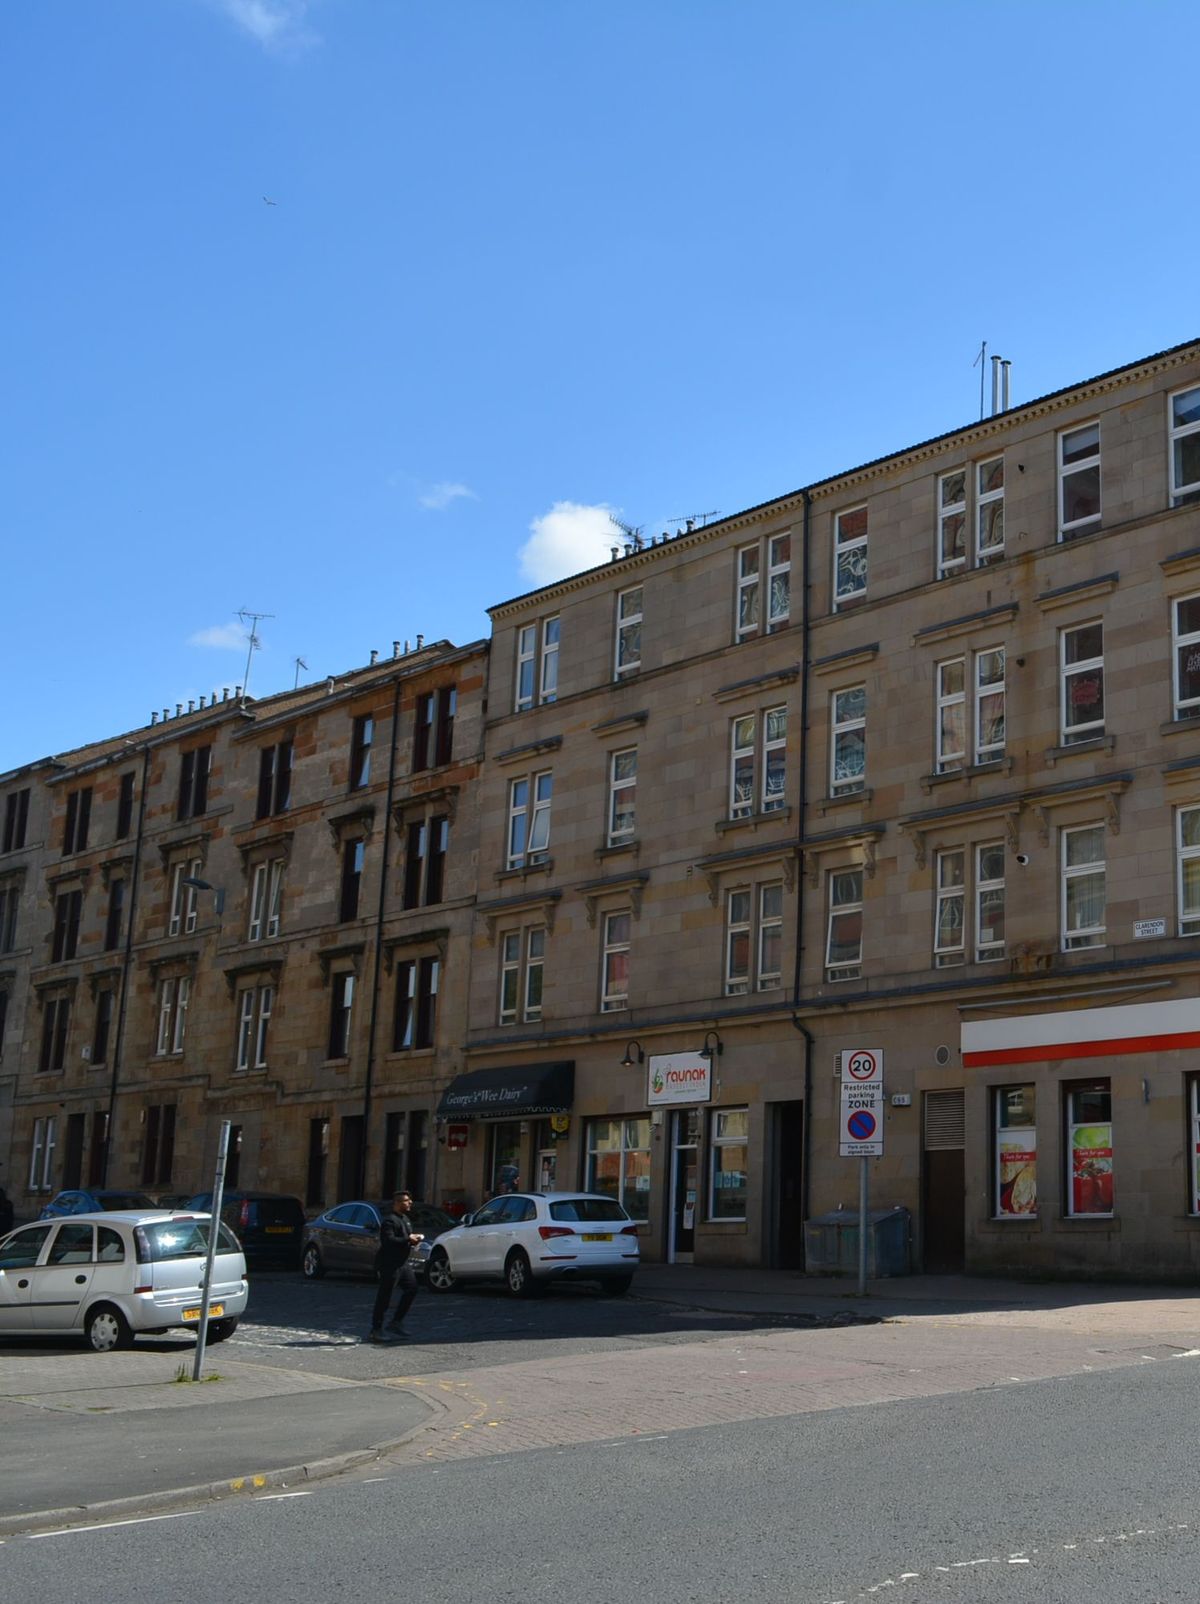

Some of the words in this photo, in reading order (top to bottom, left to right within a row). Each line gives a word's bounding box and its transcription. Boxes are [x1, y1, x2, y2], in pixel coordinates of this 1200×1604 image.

[852, 1060, 871, 1072] 20
[666, 1068, 706, 1083] raunak
[848, 1100, 875, 1109] ZONE
